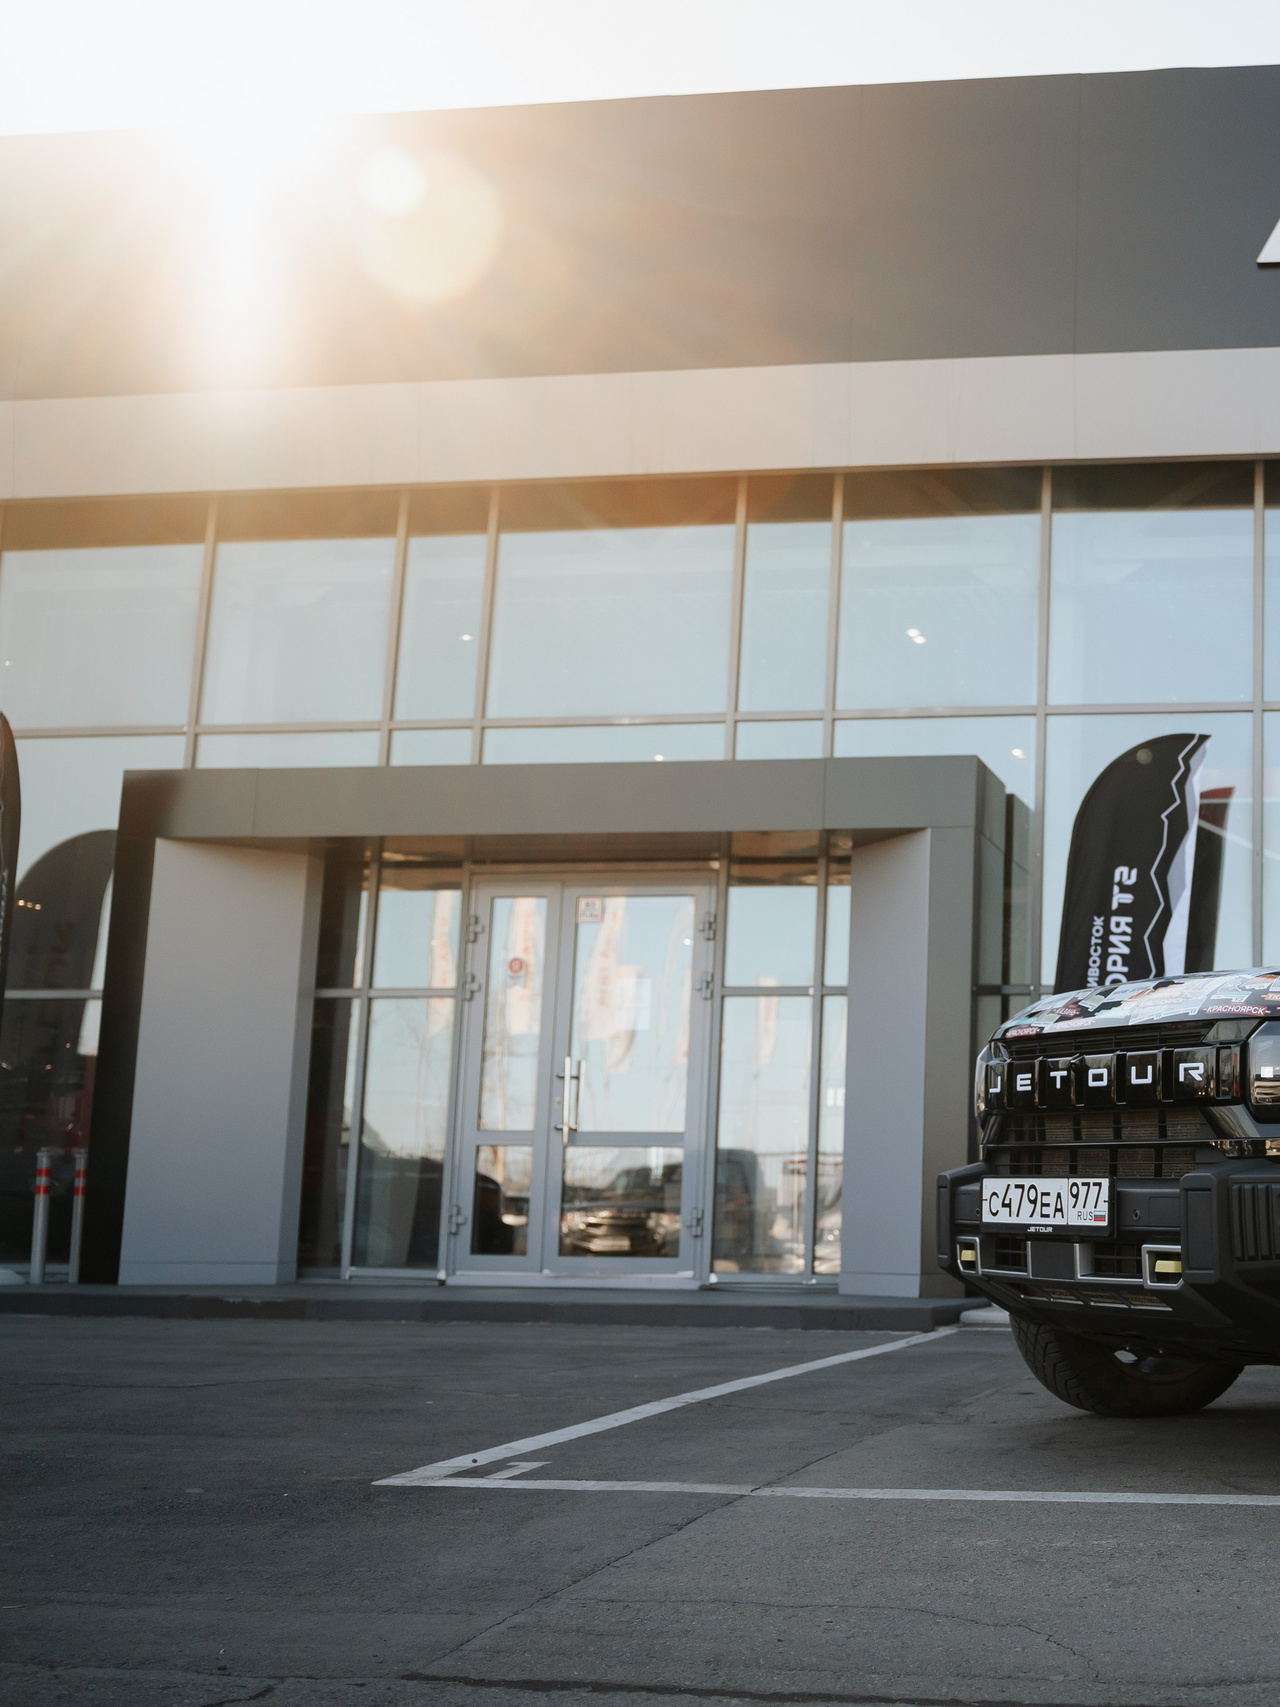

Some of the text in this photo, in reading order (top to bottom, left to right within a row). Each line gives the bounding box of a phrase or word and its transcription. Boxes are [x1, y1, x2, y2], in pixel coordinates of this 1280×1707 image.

[989, 1062, 1205, 1094] JETOUR
[1069, 1181, 1103, 1209] 977
[1077, 1210, 1094, 1221] RUS
